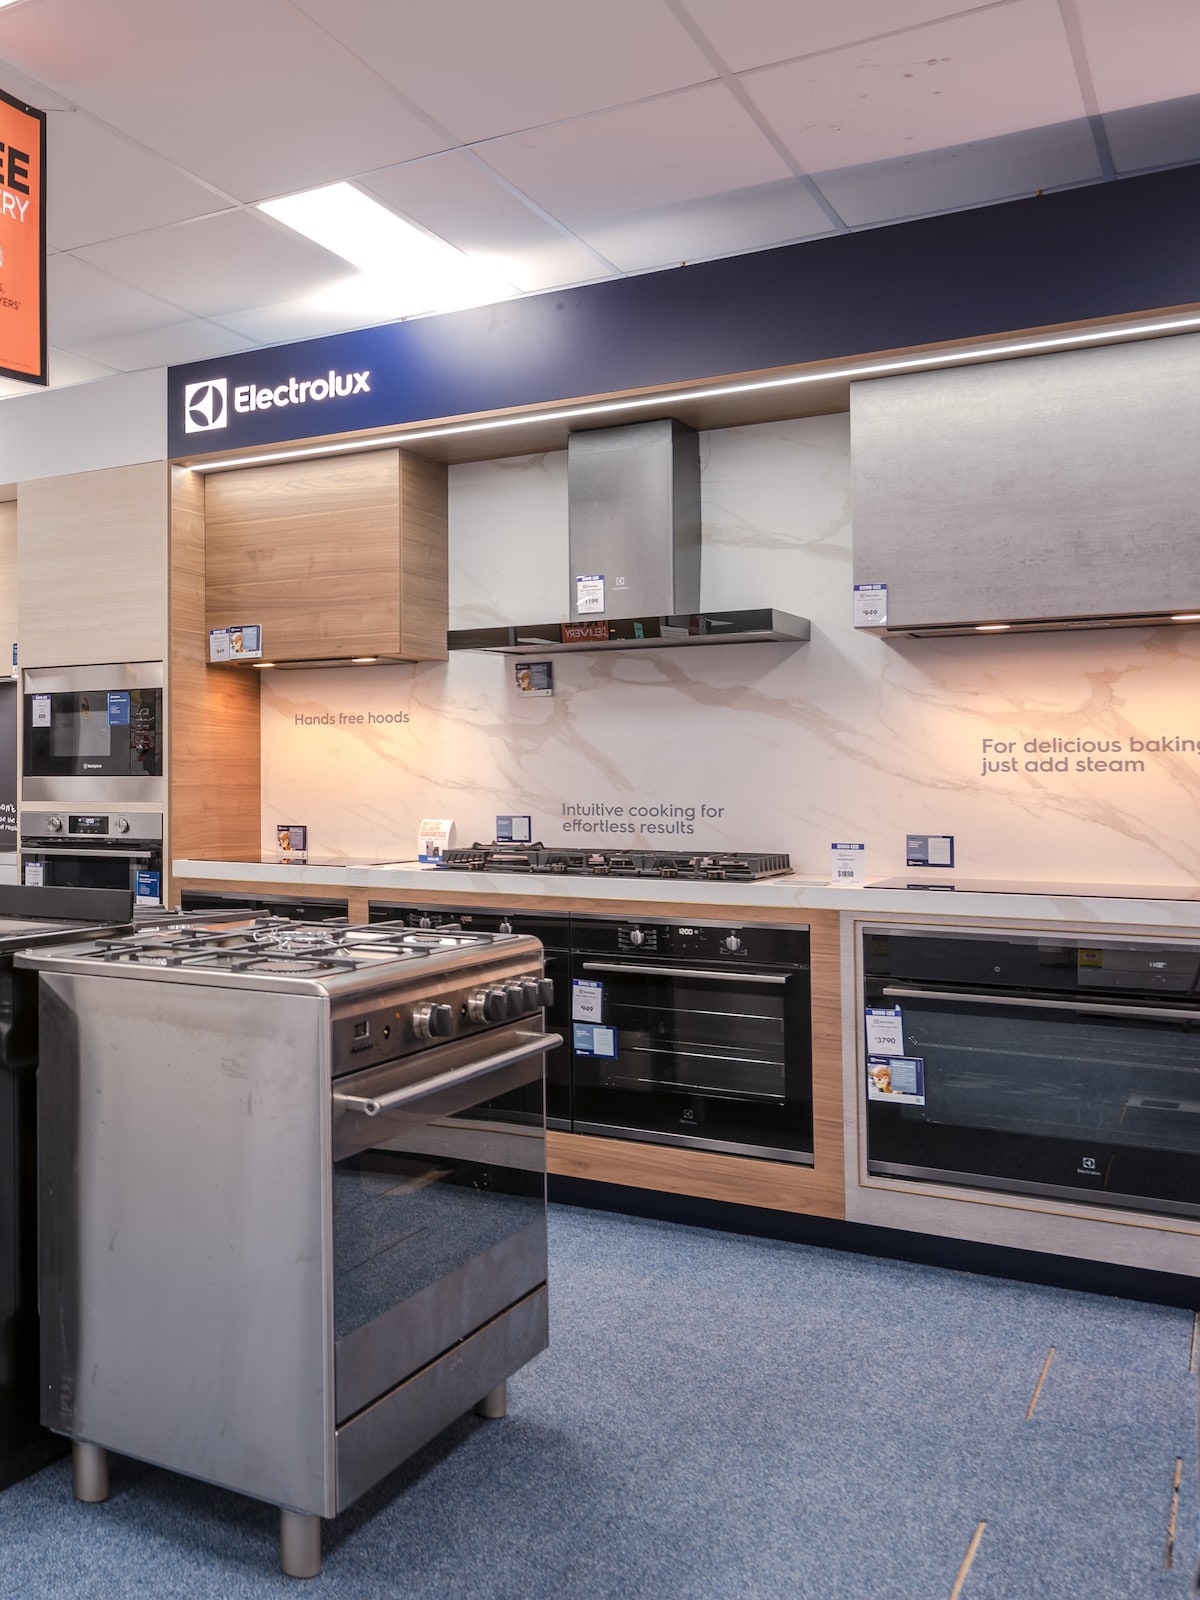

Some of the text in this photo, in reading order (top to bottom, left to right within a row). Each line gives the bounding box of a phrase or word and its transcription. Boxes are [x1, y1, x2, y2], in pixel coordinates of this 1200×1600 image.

[233, 370, 371, 413] Electrolux
[294, 711, 410, 726] Hands free hoods
[981, 736, 1200, 755] For delicious bakin
[981, 757, 1145, 777] just add steam
[562, 803, 725, 821] Intuitive cooking for
[562, 819, 695, 835] effortless results
